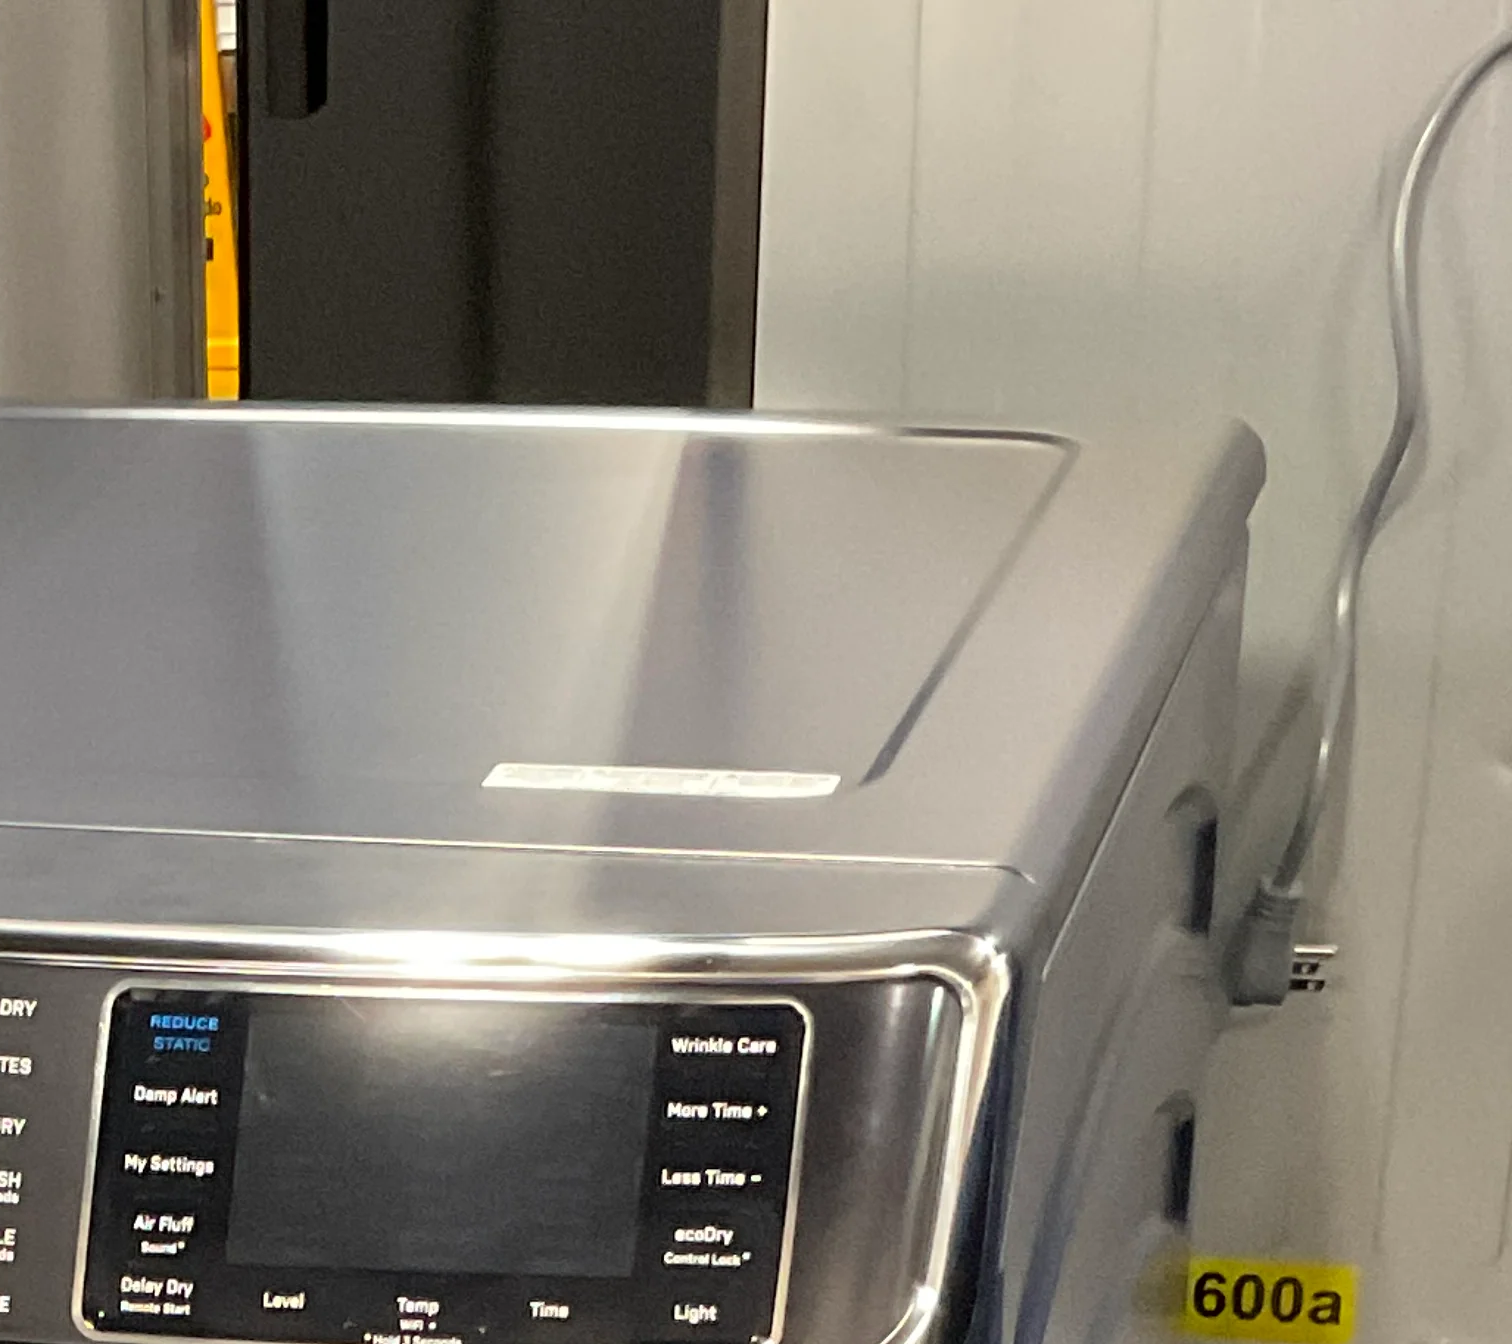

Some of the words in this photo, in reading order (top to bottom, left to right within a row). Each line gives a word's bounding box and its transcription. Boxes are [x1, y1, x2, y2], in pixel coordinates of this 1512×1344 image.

[0, 997, 37, 1017] DRY
[150, 1014, 219, 1032] REDUCE
[153, 1036, 210, 1053] STATIC
[671, 1037, 733, 1055] Wrinkle
[737, 1038, 777, 1055] Care
[134, 1085, 177, 1105] Damp
[181, 1087, 219, 1106] Alert
[667, 1102, 709, 1120] More
[712, 1102, 753, 1120] Time
[124, 1154, 148, 1174] My
[150, 1155, 215, 1177] Settings
[661, 1168, 702, 1186] Less
[705, 1169, 746, 1187] Time
[133, 1215, 156, 1232] Air
[158, 1215, 195, 1234] Fluff
[674, 1225, 734, 1246] ecoDry
[120, 1276, 163, 1297] Delay
[165, 1278, 194, 1299] Dry
[262, 1291, 305, 1311] Level
[397, 1296, 440, 1317] Temp
[1192, 1271, 1344, 1326] 600a
[529, 1301, 570, 1319] Time
[673, 1304, 718, 1325] Light
